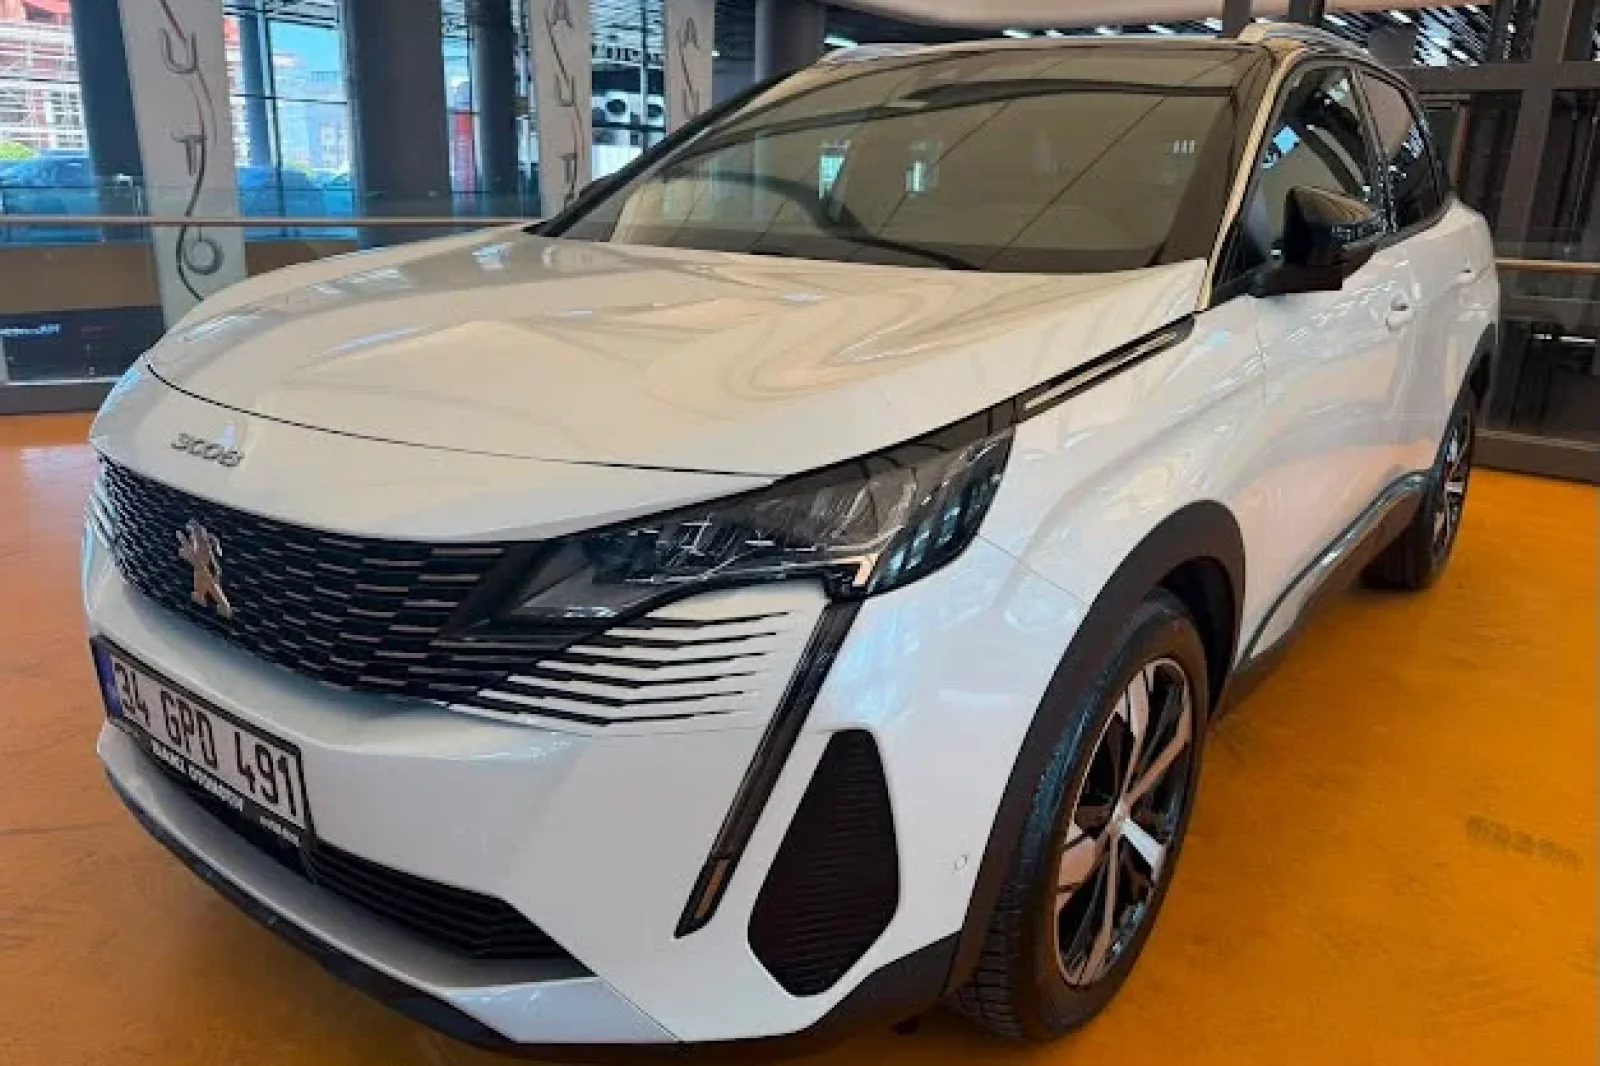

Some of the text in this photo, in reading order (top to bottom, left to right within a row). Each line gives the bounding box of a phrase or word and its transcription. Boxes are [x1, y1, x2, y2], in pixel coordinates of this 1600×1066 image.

[171, 433, 245, 468] 3008
[114, 662, 151, 729] 34
[160, 690, 218, 770] GPD
[234, 731, 297, 817] 491
